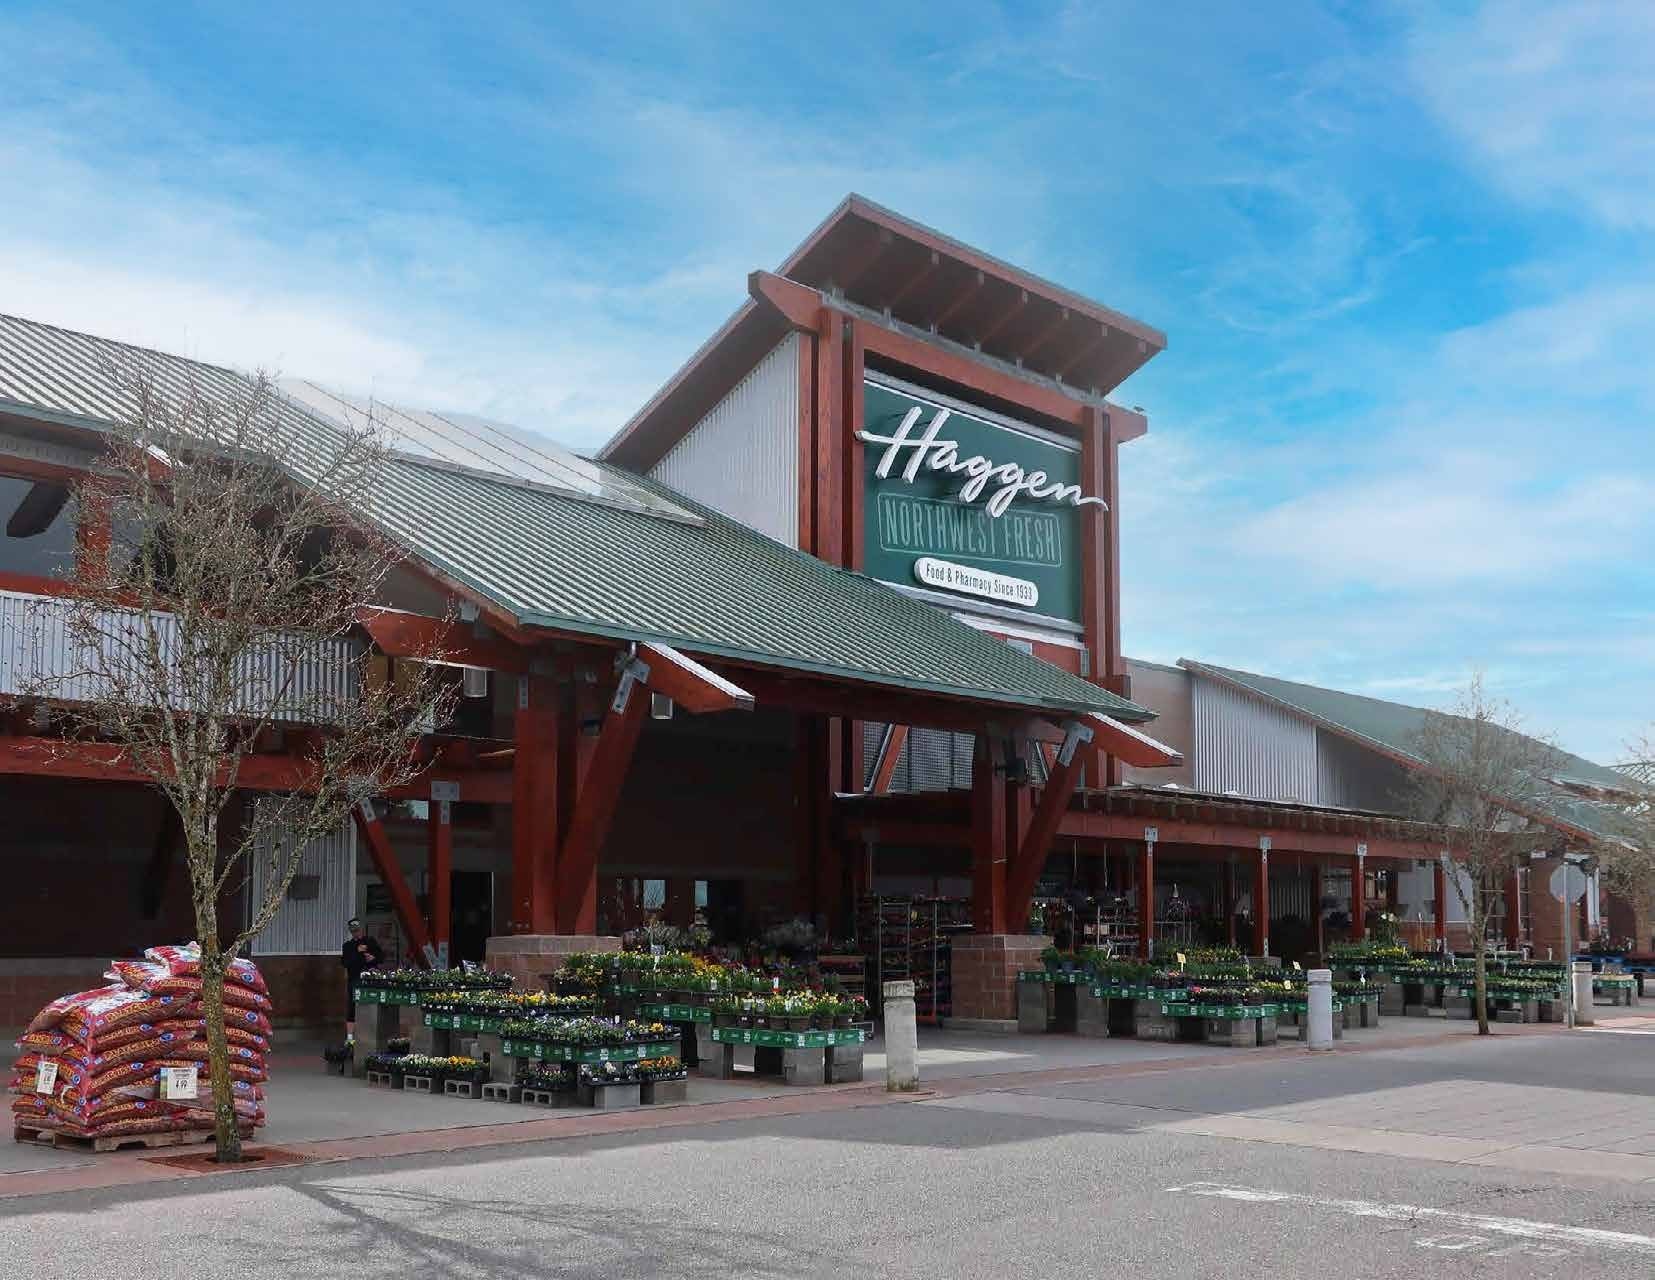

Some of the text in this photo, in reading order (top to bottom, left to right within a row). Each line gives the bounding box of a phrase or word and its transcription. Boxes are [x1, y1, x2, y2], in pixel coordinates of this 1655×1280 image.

[855, 406, 1109, 517] Haggen
[886, 500, 1055, 560] NORTHWEST FRESH
[926, 563, 1033, 600] Food & Pharmacy Since 1933
